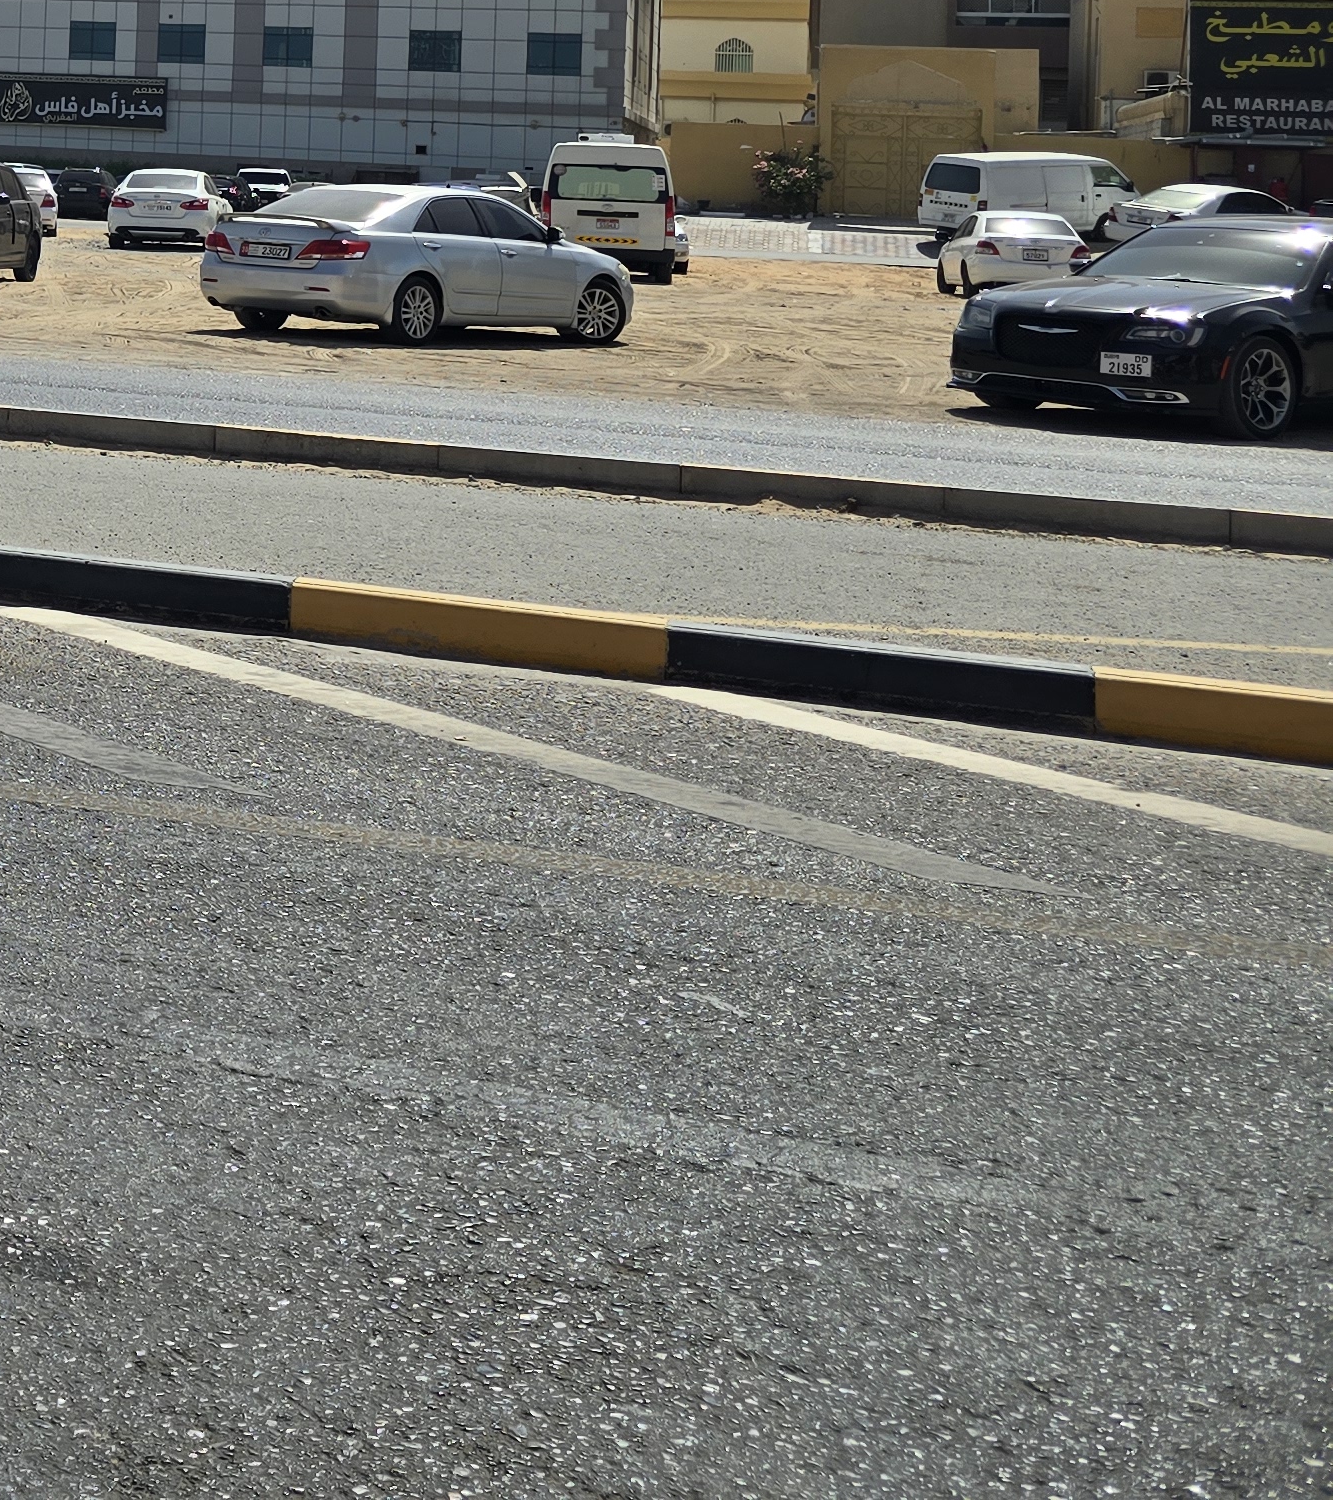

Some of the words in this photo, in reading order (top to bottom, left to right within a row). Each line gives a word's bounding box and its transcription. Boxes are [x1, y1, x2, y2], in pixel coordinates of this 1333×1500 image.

[1220, 45, 1326, 79] الشعبي
[133, 86, 165, 96] مطعم
[35, 95, 78, 115] فاس
[1201, 96, 1227, 109] AL
[1234, 97, 1333, 112] MARHABA
[261, 246, 288, 257] 23027
[1134, 355, 1149, 364] DD
[1108, 361, 1143, 375] 21935
